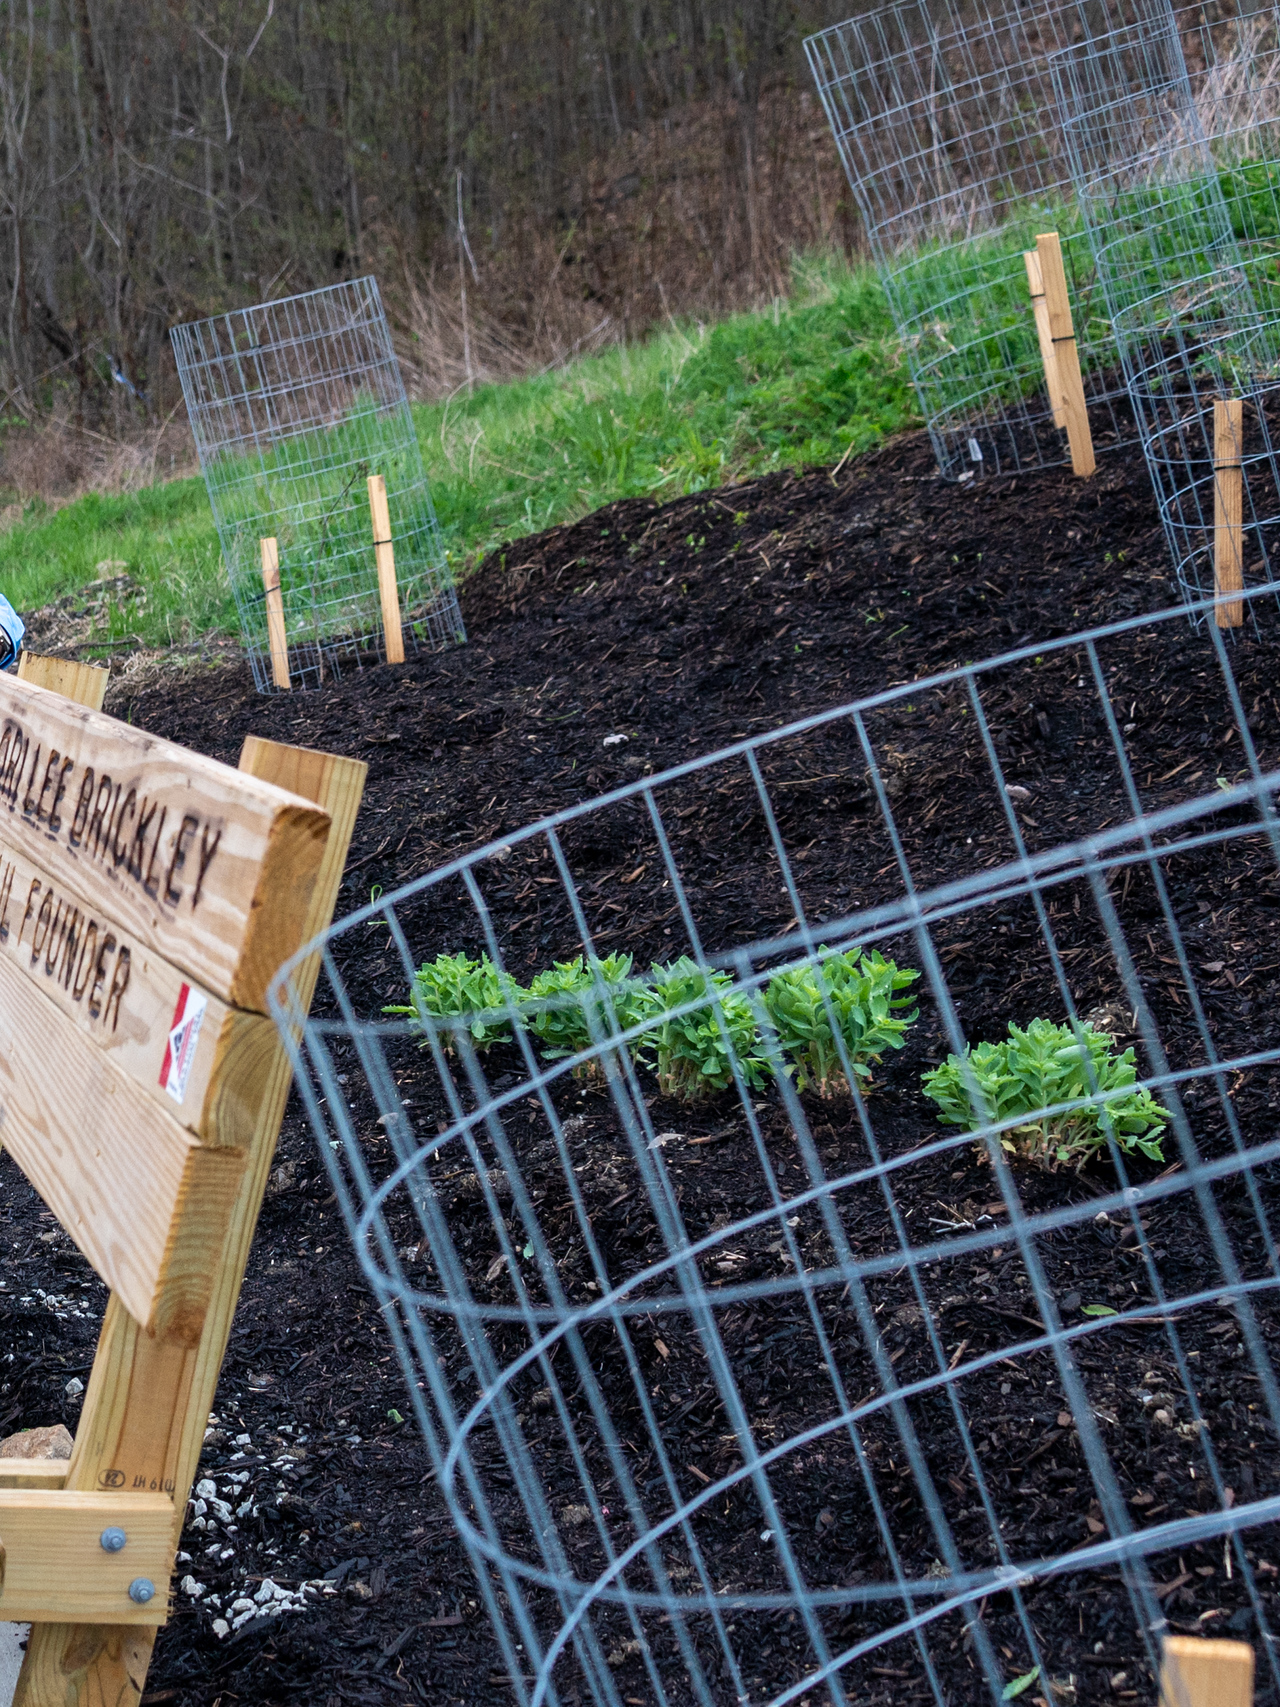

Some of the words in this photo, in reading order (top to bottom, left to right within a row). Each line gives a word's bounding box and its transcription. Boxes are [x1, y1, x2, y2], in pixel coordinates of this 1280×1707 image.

[23, 743, 74, 833] LEE
[69, 766, 222, 912] BRICKLEY
[17, 878, 132, 1033] FOUNDER
